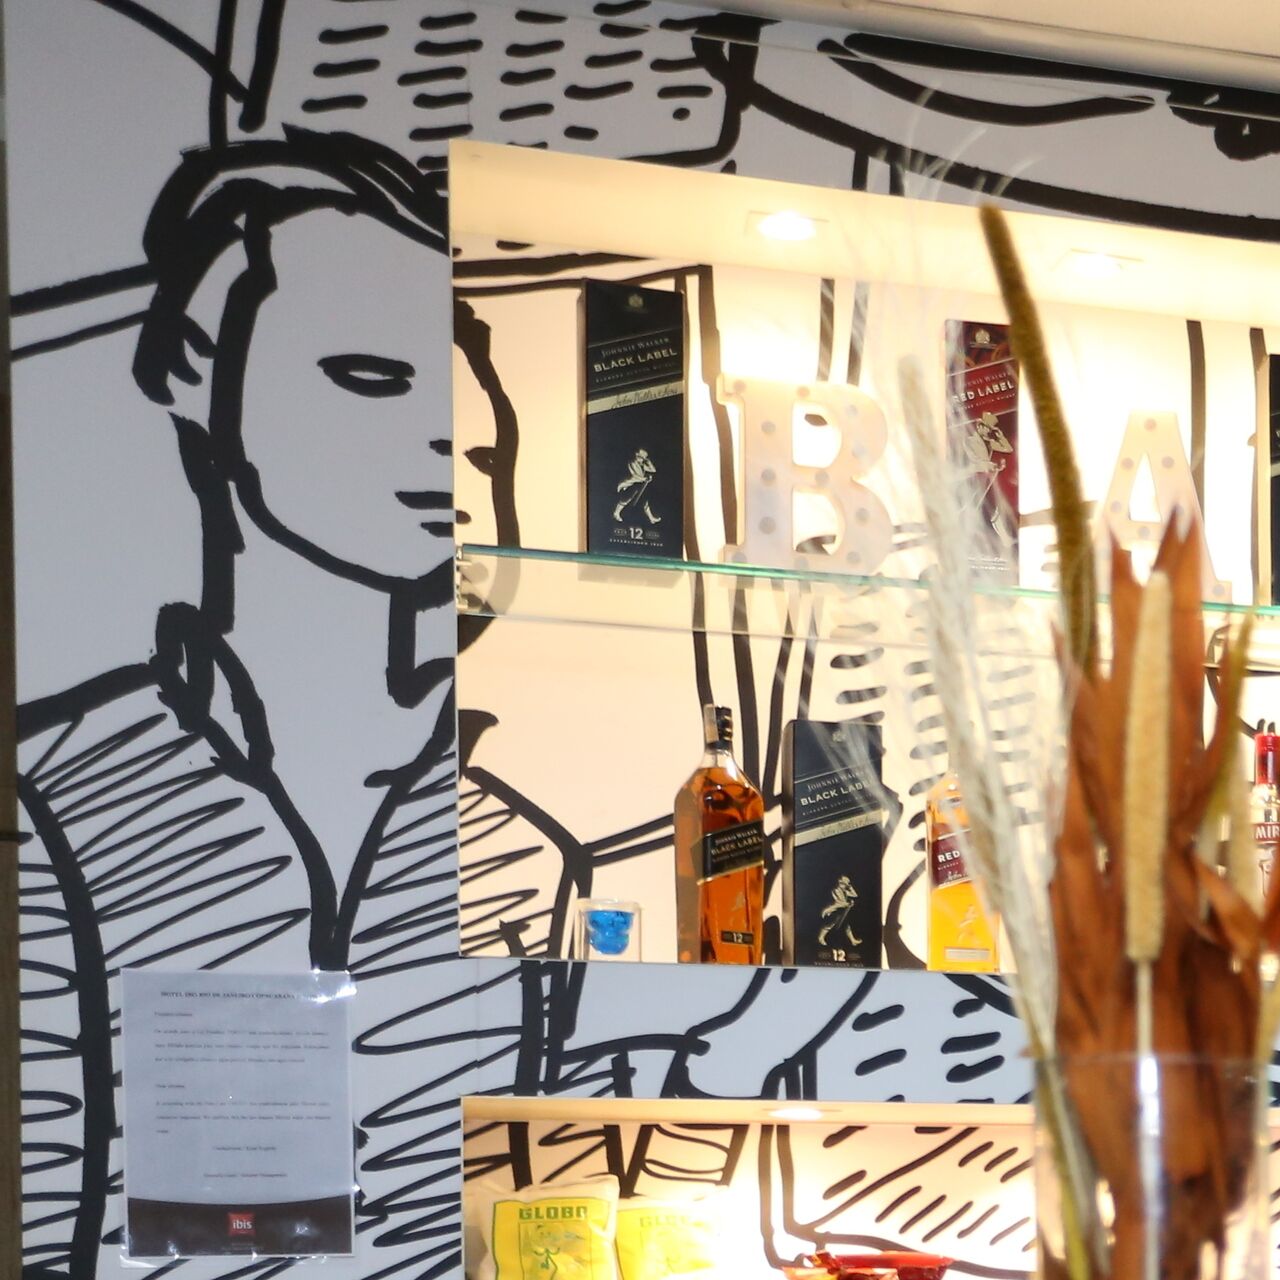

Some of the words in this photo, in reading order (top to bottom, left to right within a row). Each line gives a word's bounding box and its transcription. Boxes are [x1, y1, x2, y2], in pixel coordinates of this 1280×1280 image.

[593, 356, 635, 373] BLACK
[637, 348, 678, 363] LABEL
[977, 380, 1014, 397] LABEL
[629, 527, 644, 540] 12
[800, 789, 838, 806] BLACK
[711, 844, 736, 856] BLACK
[737, 837, 762, 848] LABEL
[937, 850, 960, 863] RED
[733, 932, 743, 943] 12
[832, 949, 846, 962] 12
[519, 1206, 588, 1220] GLOBO
[232, 1219, 253, 1230] ibis
